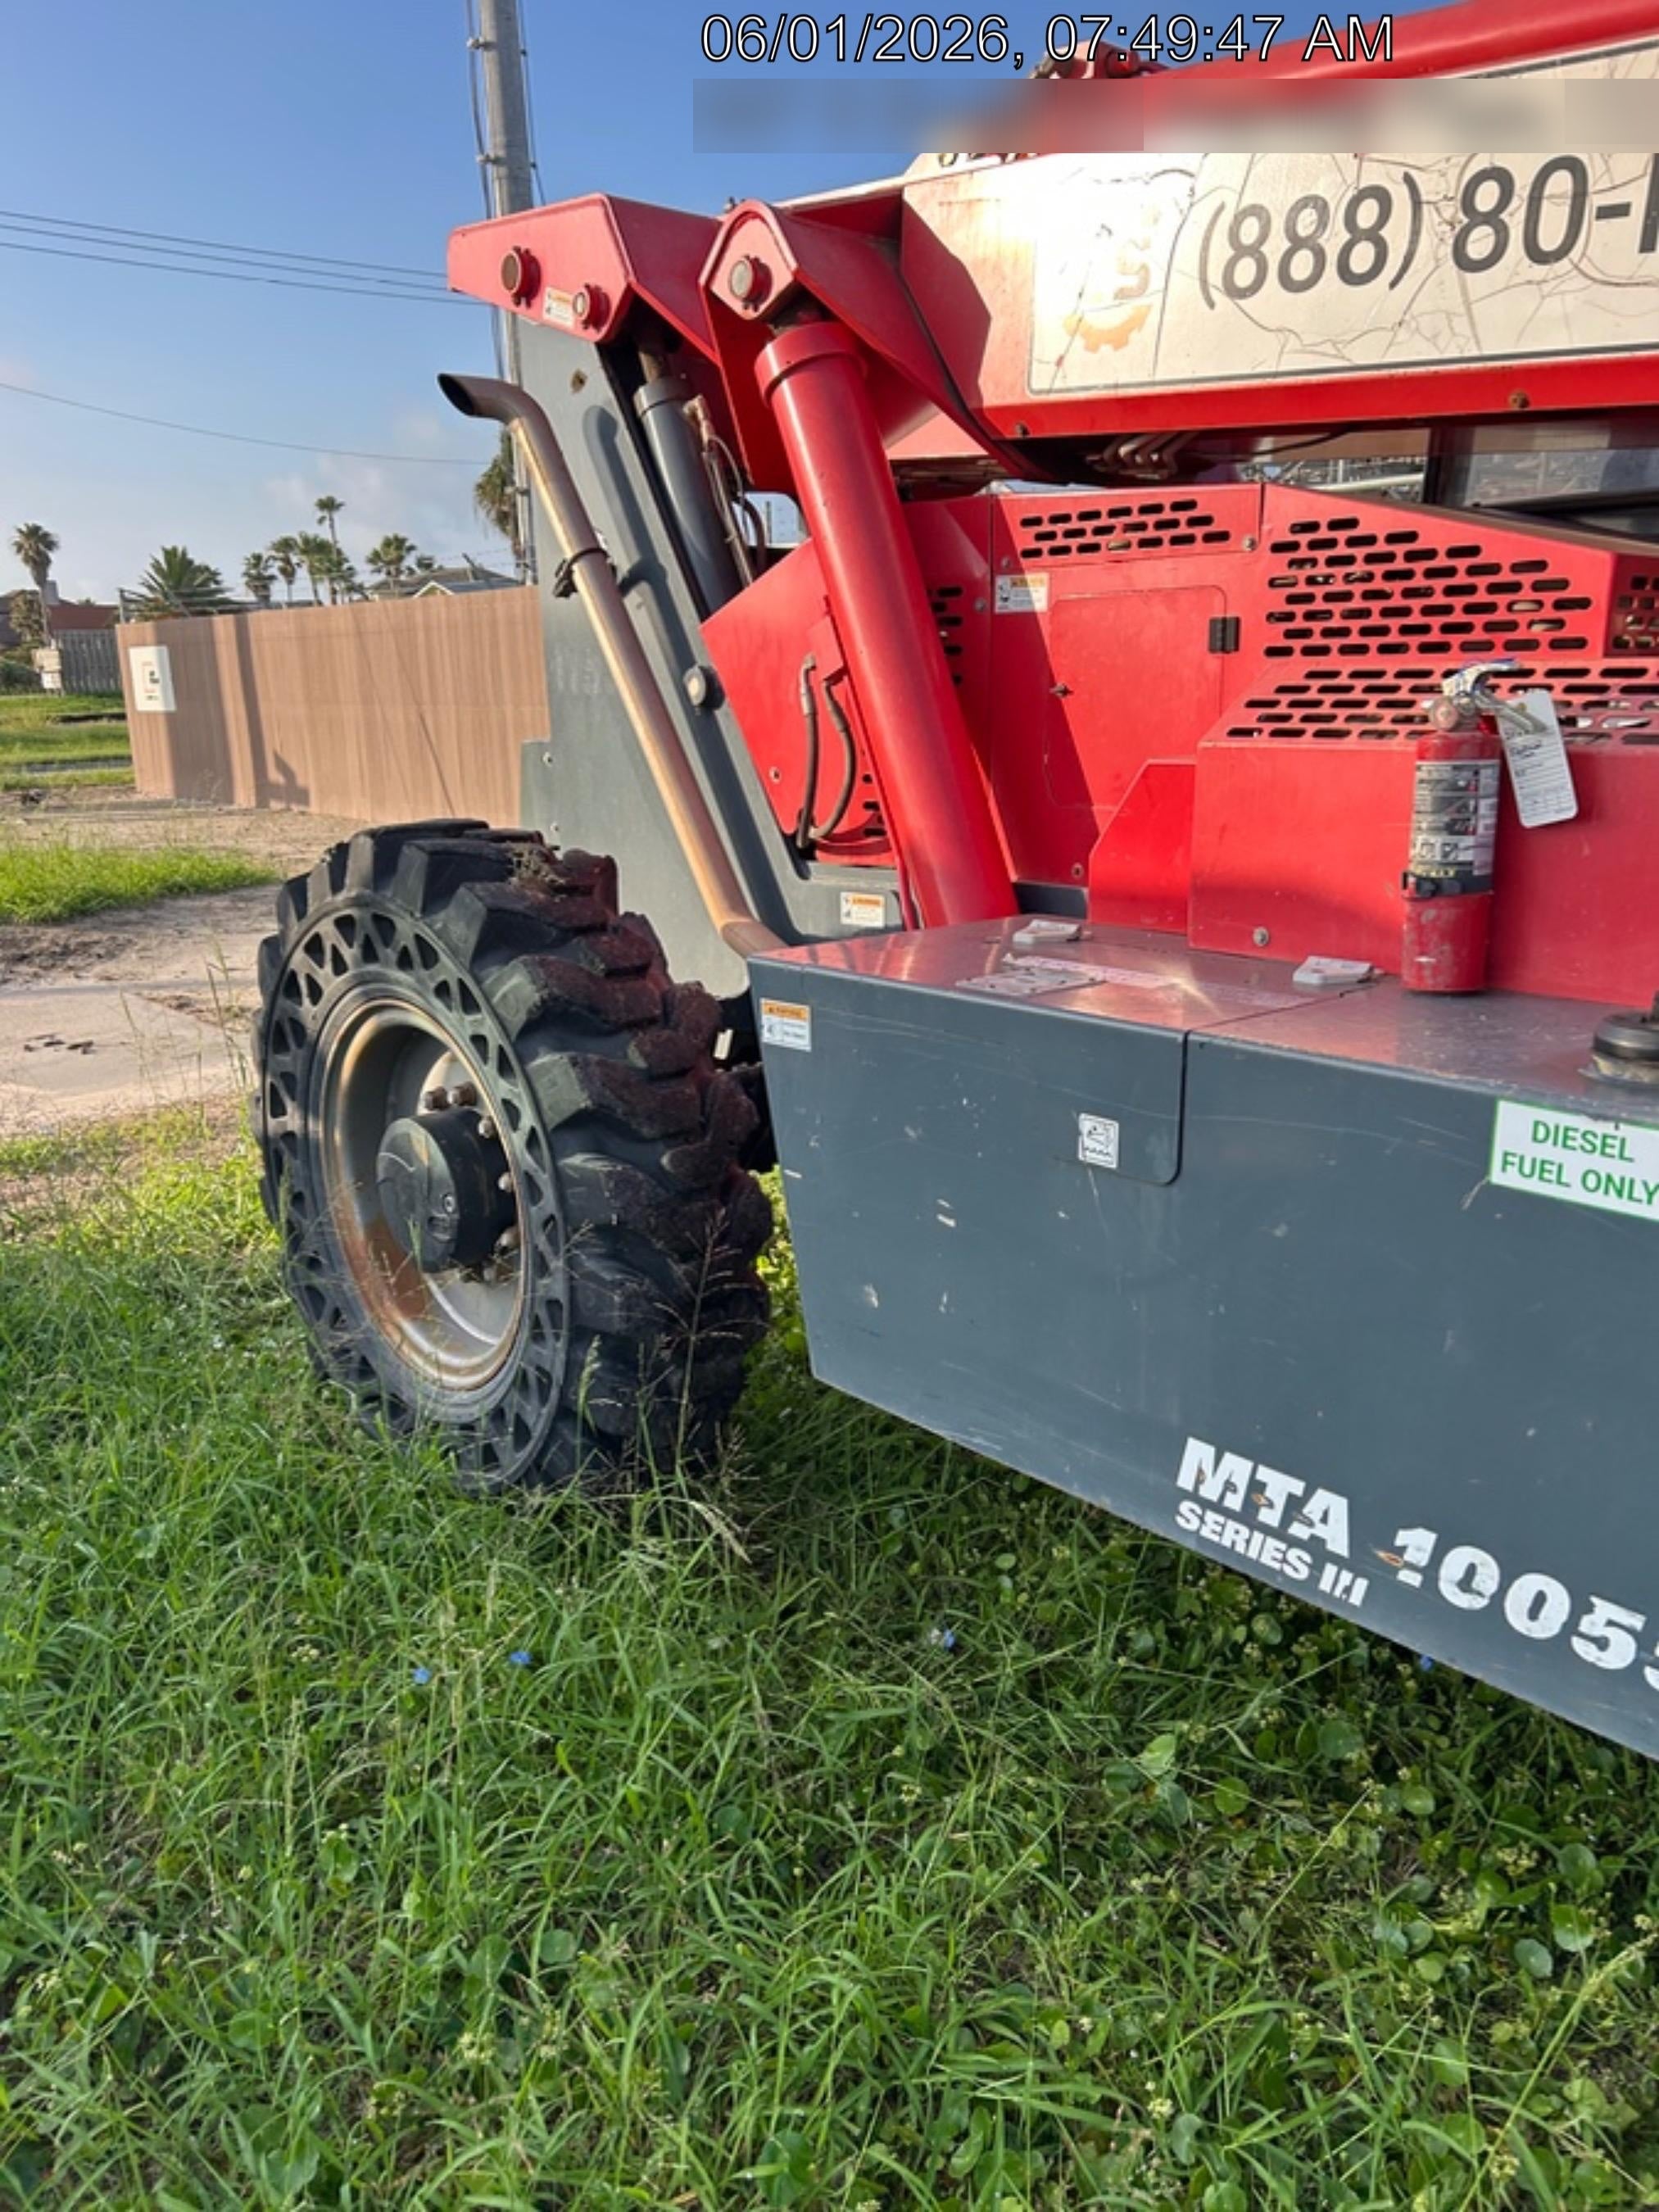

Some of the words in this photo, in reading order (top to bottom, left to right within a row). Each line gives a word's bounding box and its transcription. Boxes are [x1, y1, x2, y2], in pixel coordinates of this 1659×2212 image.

[1199, 170, 1423, 310] (888)
[1452, 153, 1659, 274] 80-
[1501, 1150, 1571, 1188] FUEL
[1580, 1168, 1659, 1205] ONLY
[1530, 1119, 1635, 1163] DIESEL
[1175, 1499, 1313, 1581] SERIES
[1317, 1562, 1371, 1608] III
[1176, 1436, 1351, 1559] MTA
[1394, 1527, 1659, 1692] 1005
